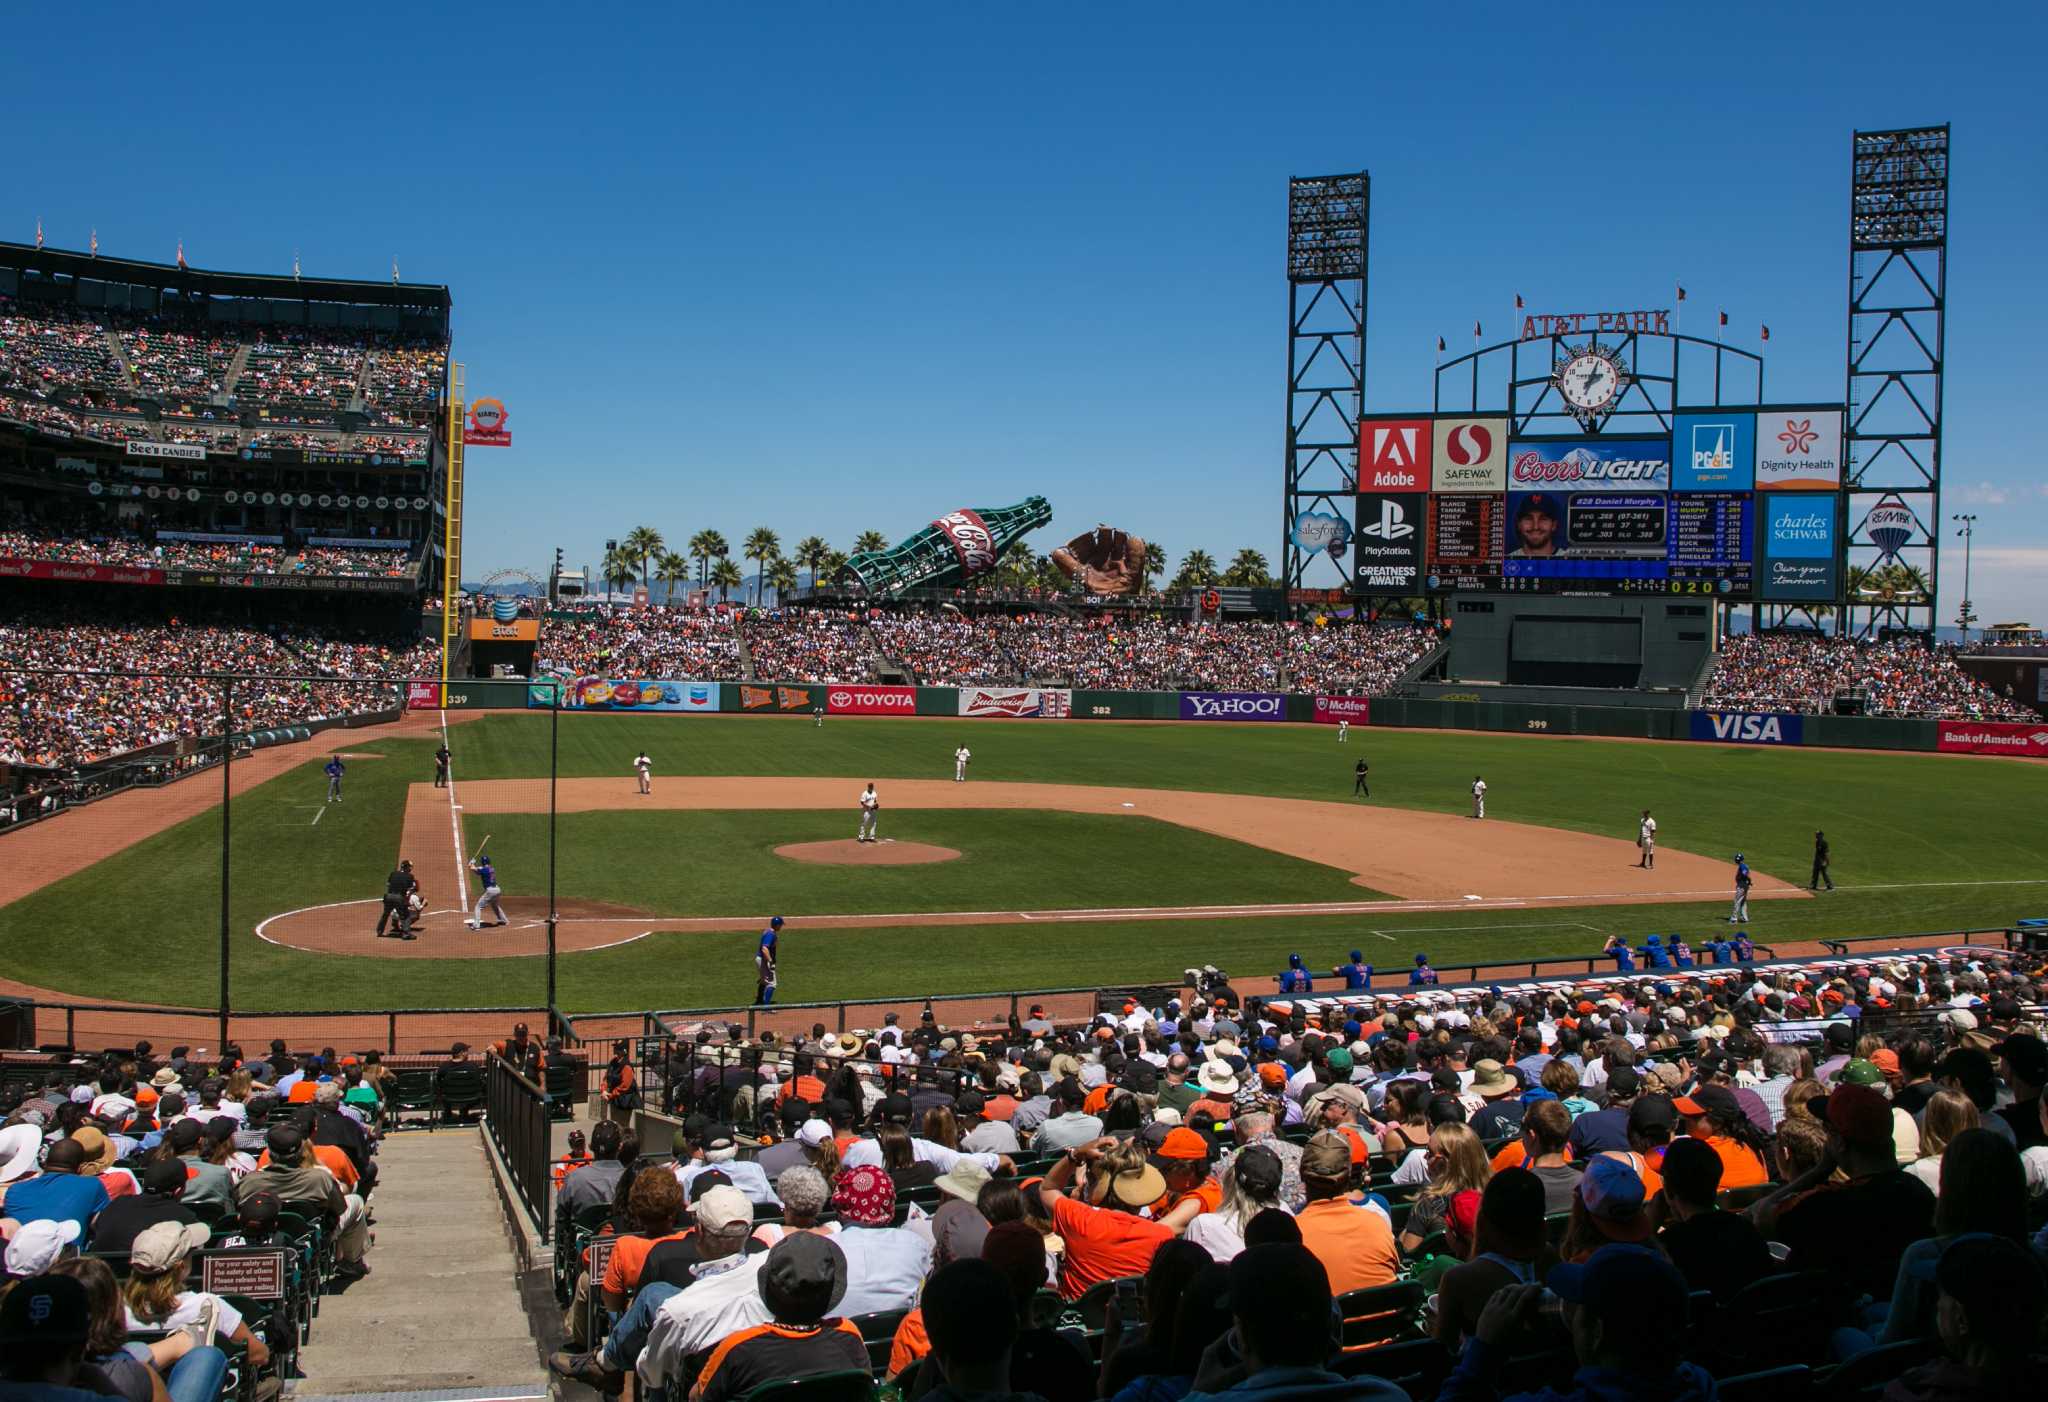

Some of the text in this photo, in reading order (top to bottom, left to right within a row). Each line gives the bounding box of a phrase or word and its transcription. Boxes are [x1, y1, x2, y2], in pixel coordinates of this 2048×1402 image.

[1520, 310, 1670, 342] AT&T PARK
[130, 443, 200, 458] See's CANDIES
[1695, 451, 1731, 467] PG&E
[1513, 450, 1665, 482] Coors LIGHT
[1761, 460, 1834, 472] Dignity Health
[1374, 472, 1415, 486] Adobe
[1445, 470, 1492, 479] SAFEWAY
[1624, 498, 1657, 507] Murphy
[1775, 513, 1827, 528] charles
[1872, 511, 1910, 524] RE/MAX
[1775, 529, 1828, 540] SCHWAB
[1365, 546, 1411, 557] PlayStation
[1358, 566, 1416, 576] GREATNESS
[1773, 562, 1826, 578] Own your
[220, 577, 242, 585] NBC
[263, 578, 280, 586] BAY
[282, 578, 308, 587] AREA
[312, 580, 336, 588] HOME
[368, 582, 400, 590] GIANTS
[1368, 576, 1408, 586] AWAITS.
[1672, 582, 1712, 592] 0 2 0
[448, 696, 468, 704] 339
[854, 693, 914, 706] TOYOTA
[973, 696, 1025, 706] Budweiser
[1187, 696, 1280, 716] YAHOO!
[1330, 700, 1366, 711] McAfee
[1092, 706, 1110, 715] 382
[1527, 720, 1547, 728] 399
[1707, 714, 1782, 741] VISA
[1944, 732, 2028, 745] Bank of America
[1360, 972, 1367, 985] 7
